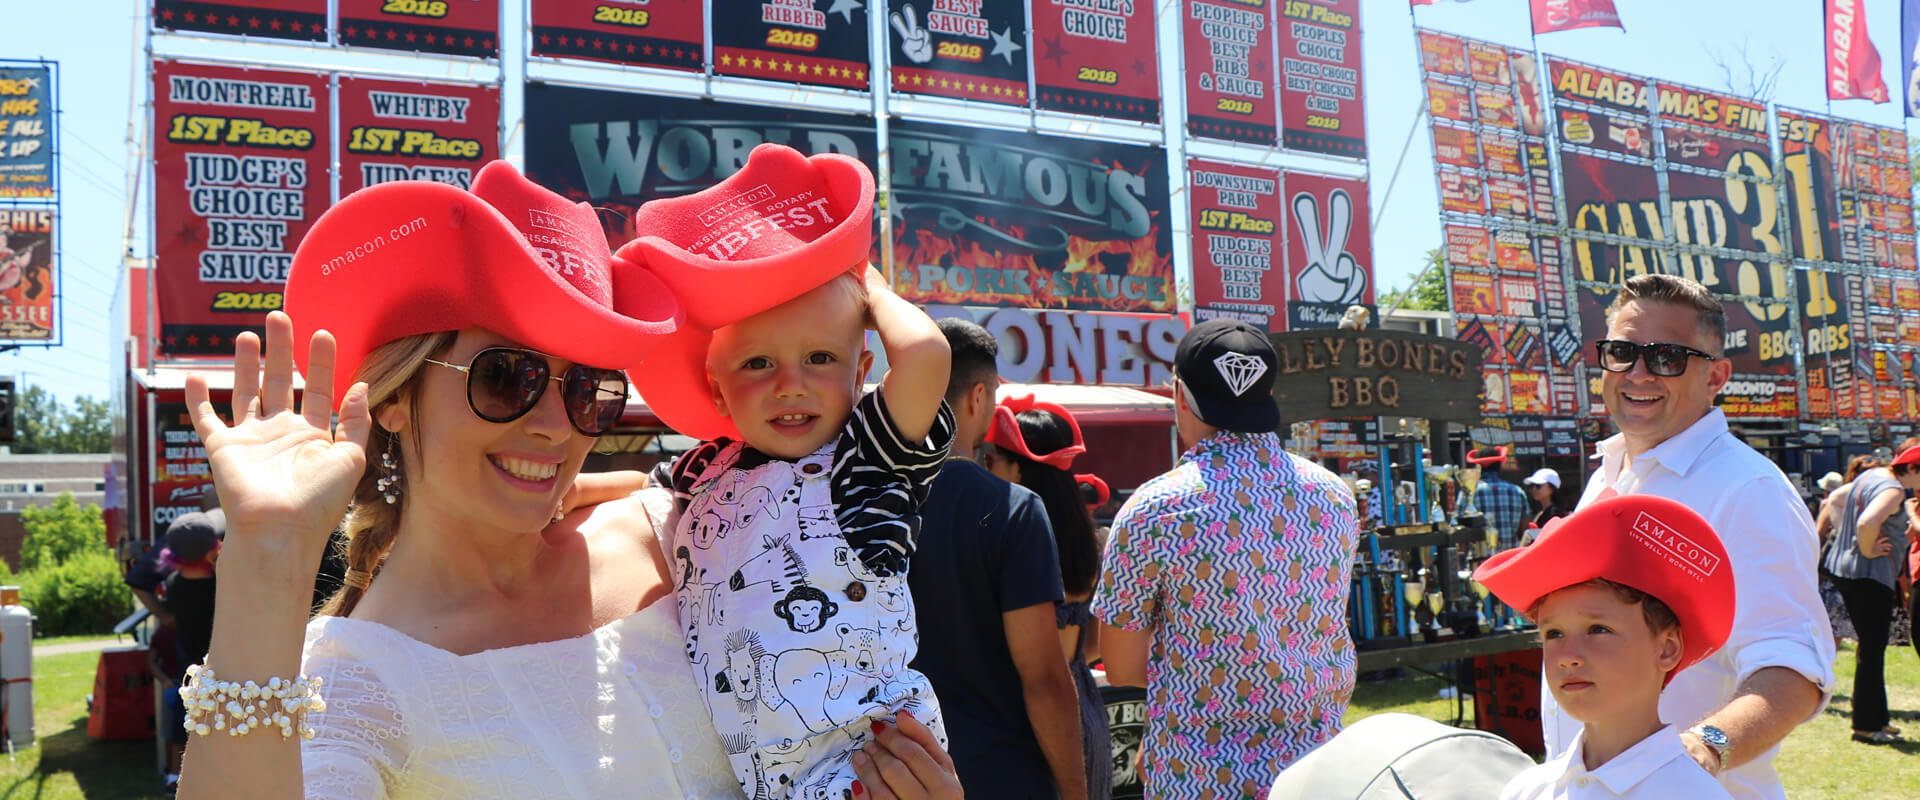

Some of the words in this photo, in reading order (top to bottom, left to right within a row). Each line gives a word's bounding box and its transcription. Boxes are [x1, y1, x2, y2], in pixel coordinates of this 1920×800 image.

[384, 0, 447, 17] 2018
[594, 6, 649, 25] 2018
[764, 5, 825, 28] RIBBER
[1194, 3, 1264, 29] PEOPLE'S
[1285, 0, 1311, 18] 1ST
[1312, 6, 1352, 28] Place
[930, 13, 988, 38] SAUCE
[1064, 10, 1127, 42] CHOICE
[1202, 22, 1257, 44] CHOICE
[767, 28, 817, 48] 2018
[1211, 41, 1249, 59] BEST
[937, 41, 982, 60] 2018
[1298, 41, 1343, 61] CHOICE
[1079, 66, 1118, 84] 2018
[1214, 60, 1248, 77] RIBS
[1322, 66, 1356, 82] CHOICE
[170, 77, 314, 111] MONTREAL
[1200, 74, 1212, 90] &
[1218, 77, 1263, 98] SAUCE
[1287, 77, 1312, 92] BEST
[1314, 81, 1355, 99] CHICKEN
[1557, 67, 1720, 122] ALABAMA'S
[370, 92, 469, 121] WHITBY
[1217, 98, 1253, 114] 2018
[1316, 98, 1338, 113] RIBS
[169, 116, 225, 142] 1ST
[226, 119, 313, 148] Place
[1306, 114, 1340, 130] 2018
[348, 128, 401, 151] 1ST
[400, 131, 480, 157] Place
[187, 155, 306, 188] JUDGE'S
[1195, 171, 1274, 194] DOWNSVIEW
[766, 190, 813, 212] ROTARY
[891, 140, 1151, 238] FAMOUS
[1219, 191, 1256, 209] PARK
[191, 188, 303, 219] CHOICE
[707, 189, 769, 221] AMACON
[1200, 209, 1229, 228] 1ST
[1230, 212, 1274, 234] Place
[208, 219, 286, 249] BEST
[321, 216, 428, 276] amacon.com
[1209, 235, 1271, 254] JUDGE'S
[1575, 199, 1727, 296] CAMP
[1725, 152, 1838, 320] 31
[201, 252, 290, 281] SAUCE
[1213, 253, 1269, 270] CHOICE
[917, 263, 1032, 295] PORK
[1053, 270, 1168, 302] SAUCE
[1224, 268, 1262, 284] BEST
[213, 291, 284, 310] 2018
[1224, 284, 1261, 299] RIBS
[924, 304, 1190, 388] ONES
[1808, 324, 1849, 355] RIBS
[1356, 337, 1468, 379] BONES
[1329, 376, 1400, 408] BBQ
[1717, 381, 1776, 396] ORONTO
[1630, 531, 1644, 543] LIVE
[1644, 540, 1662, 556] WELL
[1640, 520, 1712, 568] AMACON
